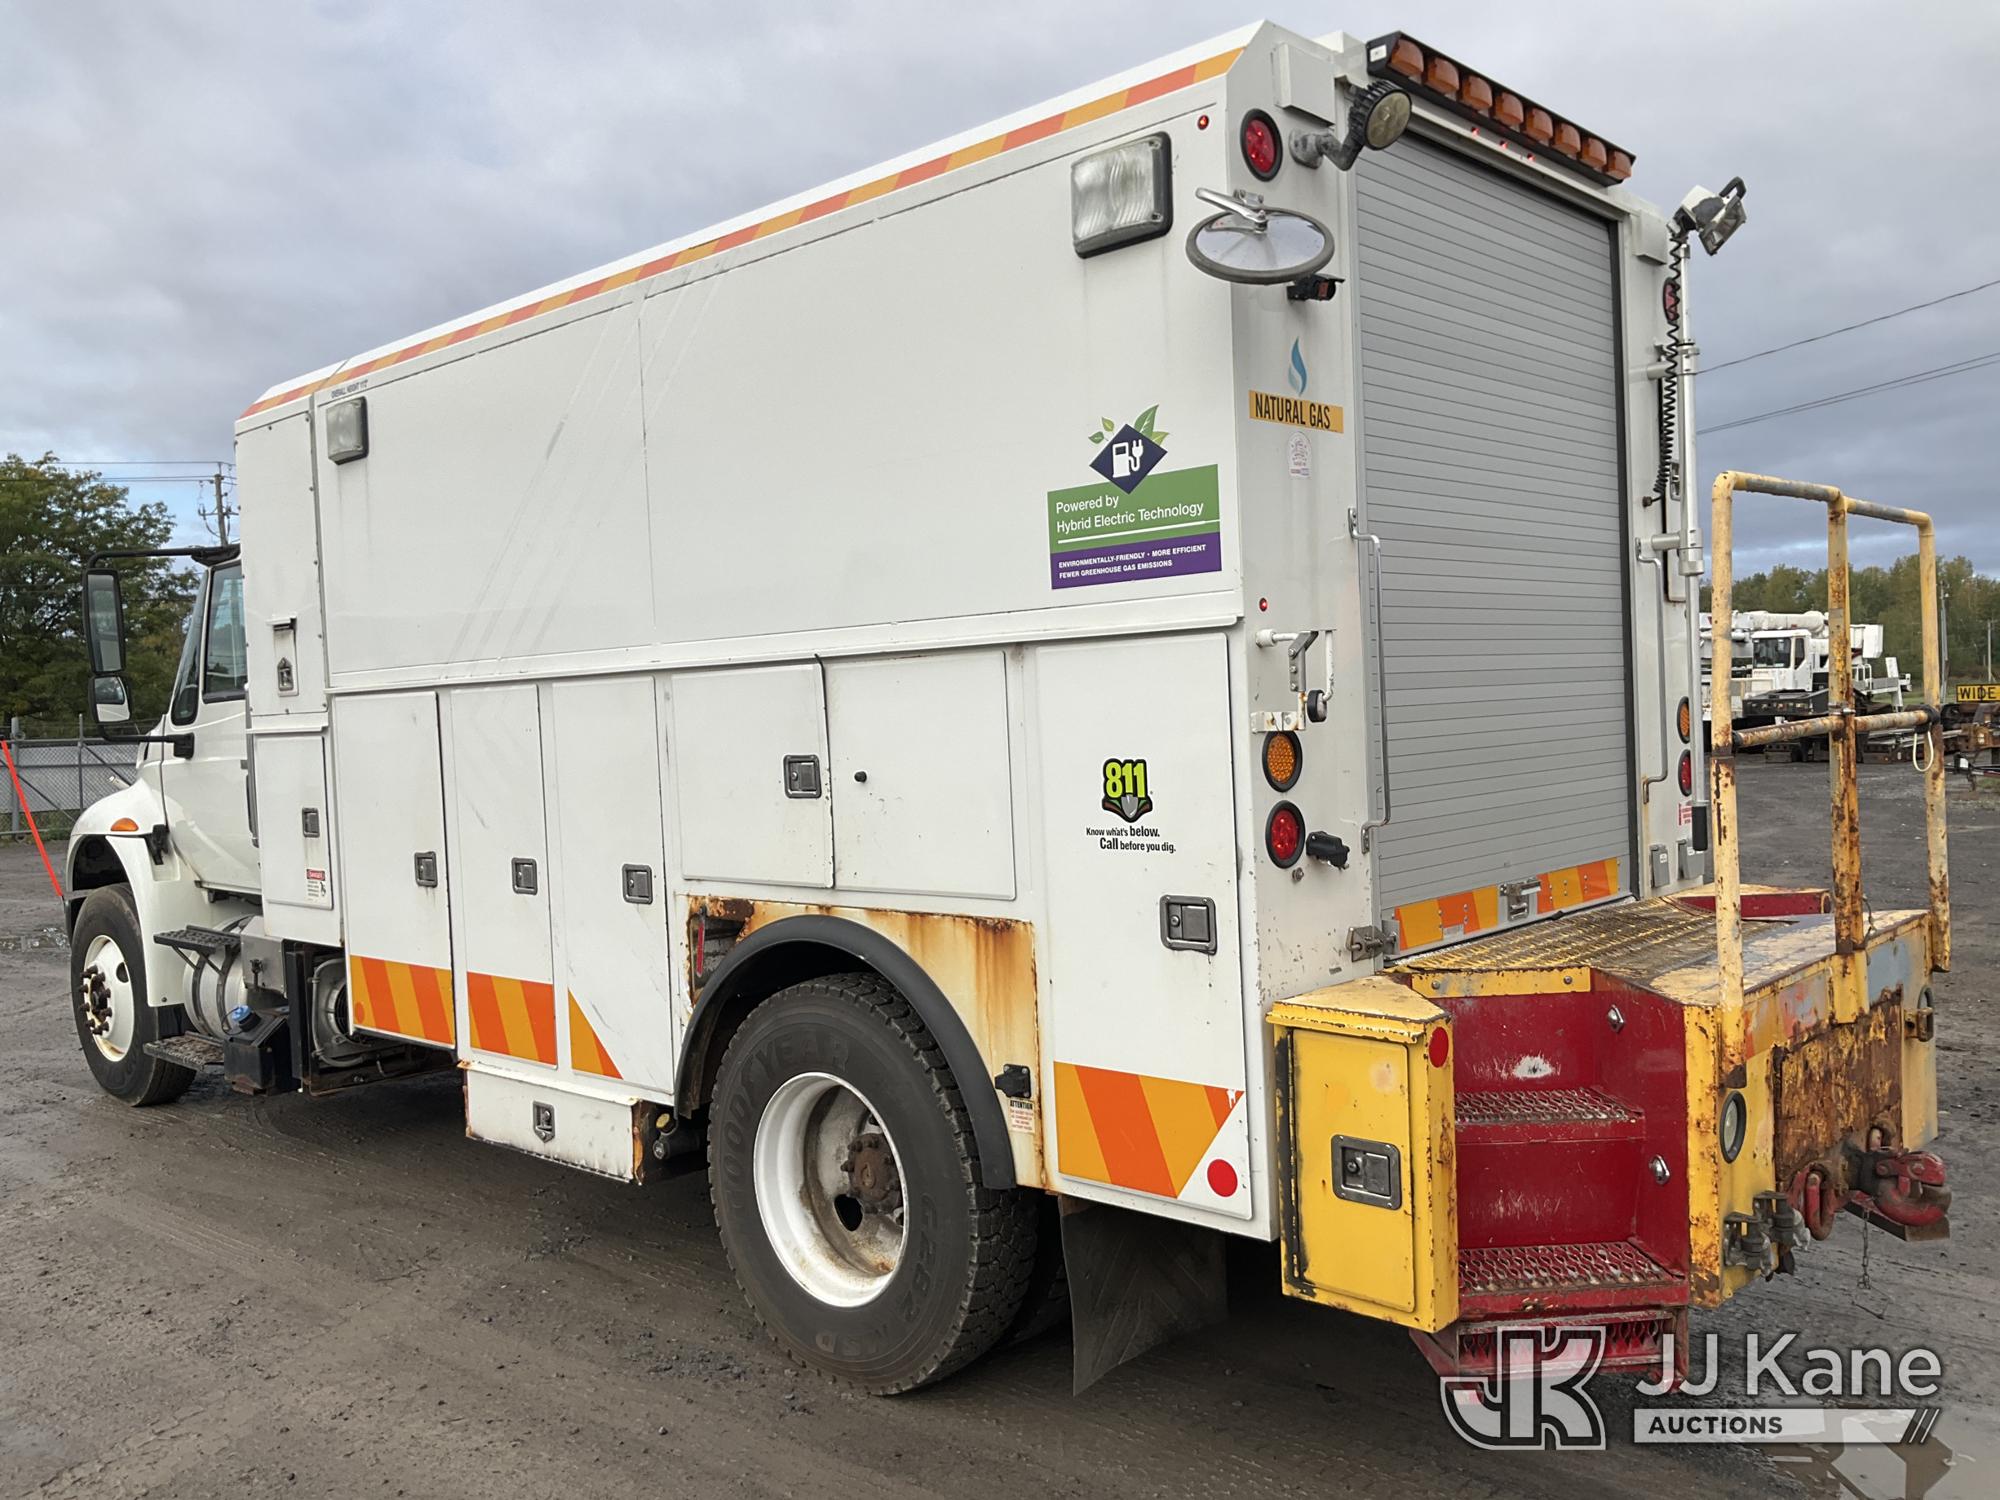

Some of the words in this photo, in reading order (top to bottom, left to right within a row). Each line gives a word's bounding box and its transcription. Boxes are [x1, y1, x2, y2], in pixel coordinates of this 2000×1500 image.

[1254, 393, 1306, 426] NATURAL
[1309, 403, 1331, 430] GAS
[1055, 496, 1103, 515] Powered
[1105, 494, 1119, 510] by
[1056, 514, 1092, 534] Hybrid
[1094, 508, 1136, 528] Electric
[1138, 502, 1204, 522] Technology
[1058, 551, 1146, 569] ENVIRONMENTALLY-FRIENDLY
[1151, 548, 1171, 558] MORE
[1172, 543, 1207, 555] EFFICIENT
[1058, 569, 1080, 580] FEWER
[1080, 564, 1121, 577] GREENHOUSE
[1122, 563, 1136, 573] GAS
[1137, 559, 1173, 571] EMISSIONS
[1959, 687, 1996, 699] WIDE
[1105, 761, 1146, 798] 811
[1086, 827, 1105, 836] Know
[1106, 827, 1128, 837] what's
[1129, 825, 1160, 837] below.
[1100, 837, 1119, 850] Call
[1120, 841, 1145, 851] before
[1146, 844, 1160, 853] you
[1161, 842, 1177, 854] dig.
